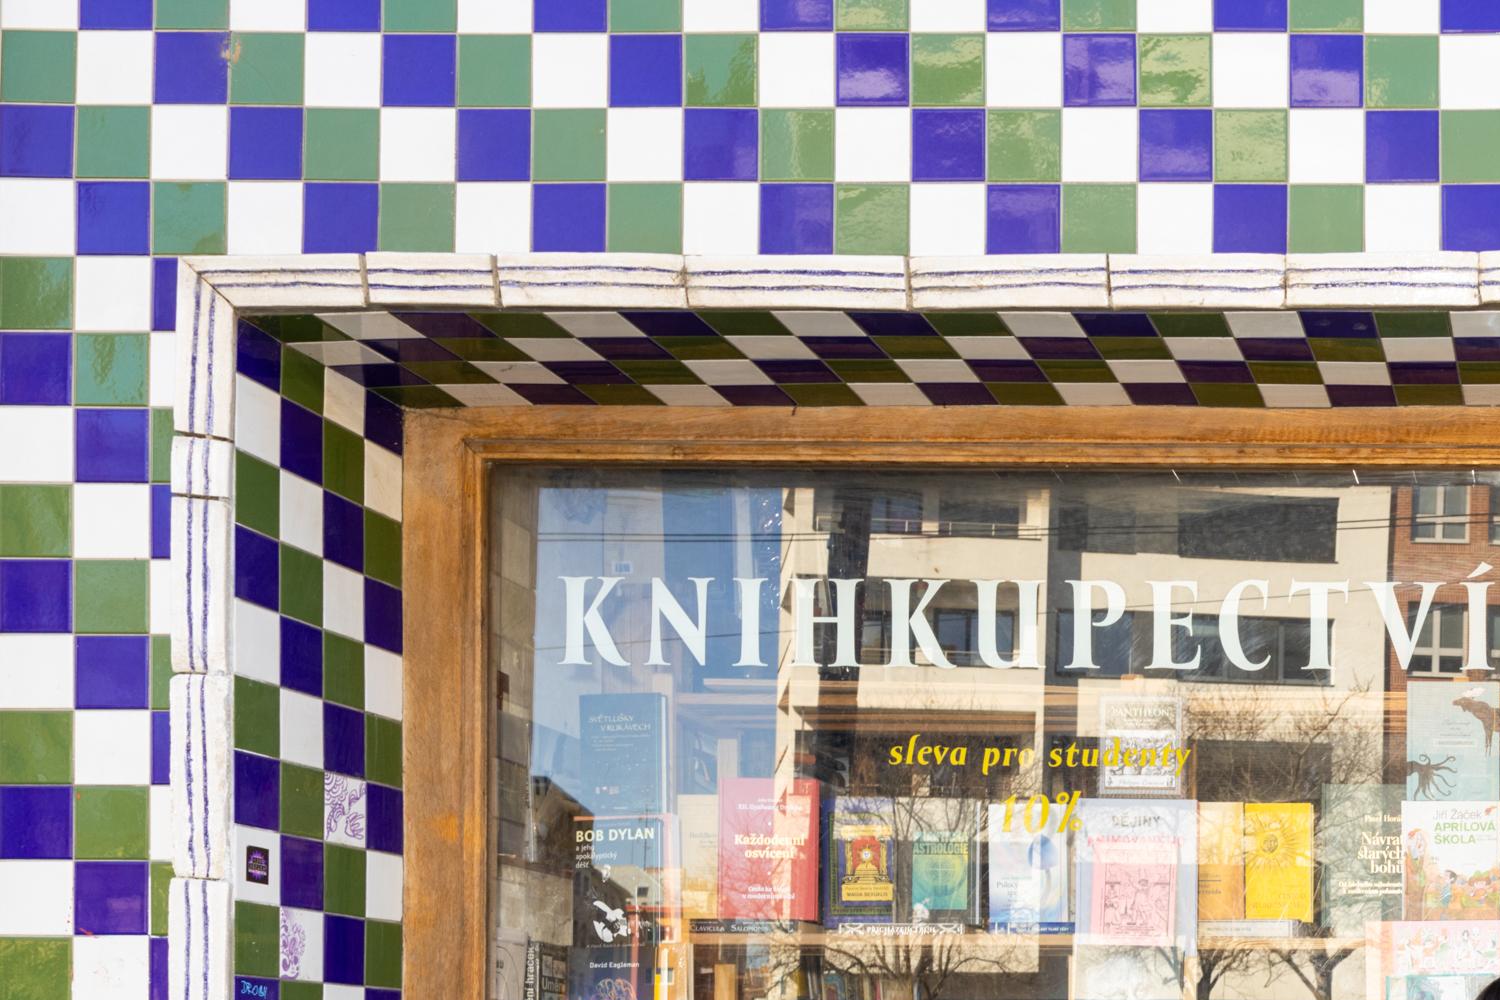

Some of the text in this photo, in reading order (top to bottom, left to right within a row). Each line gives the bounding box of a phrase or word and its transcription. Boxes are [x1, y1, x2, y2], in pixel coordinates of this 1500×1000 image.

[557, 561, 1496, 672] KNIHKUPECTVÍ
[888, 733, 1191, 777] sleva pro studenty
[1000, 790, 1083, 834] 10%
[575, 827, 655, 843] BOB DYLAN
[1434, 833, 1477, 844] ŠKOLA
